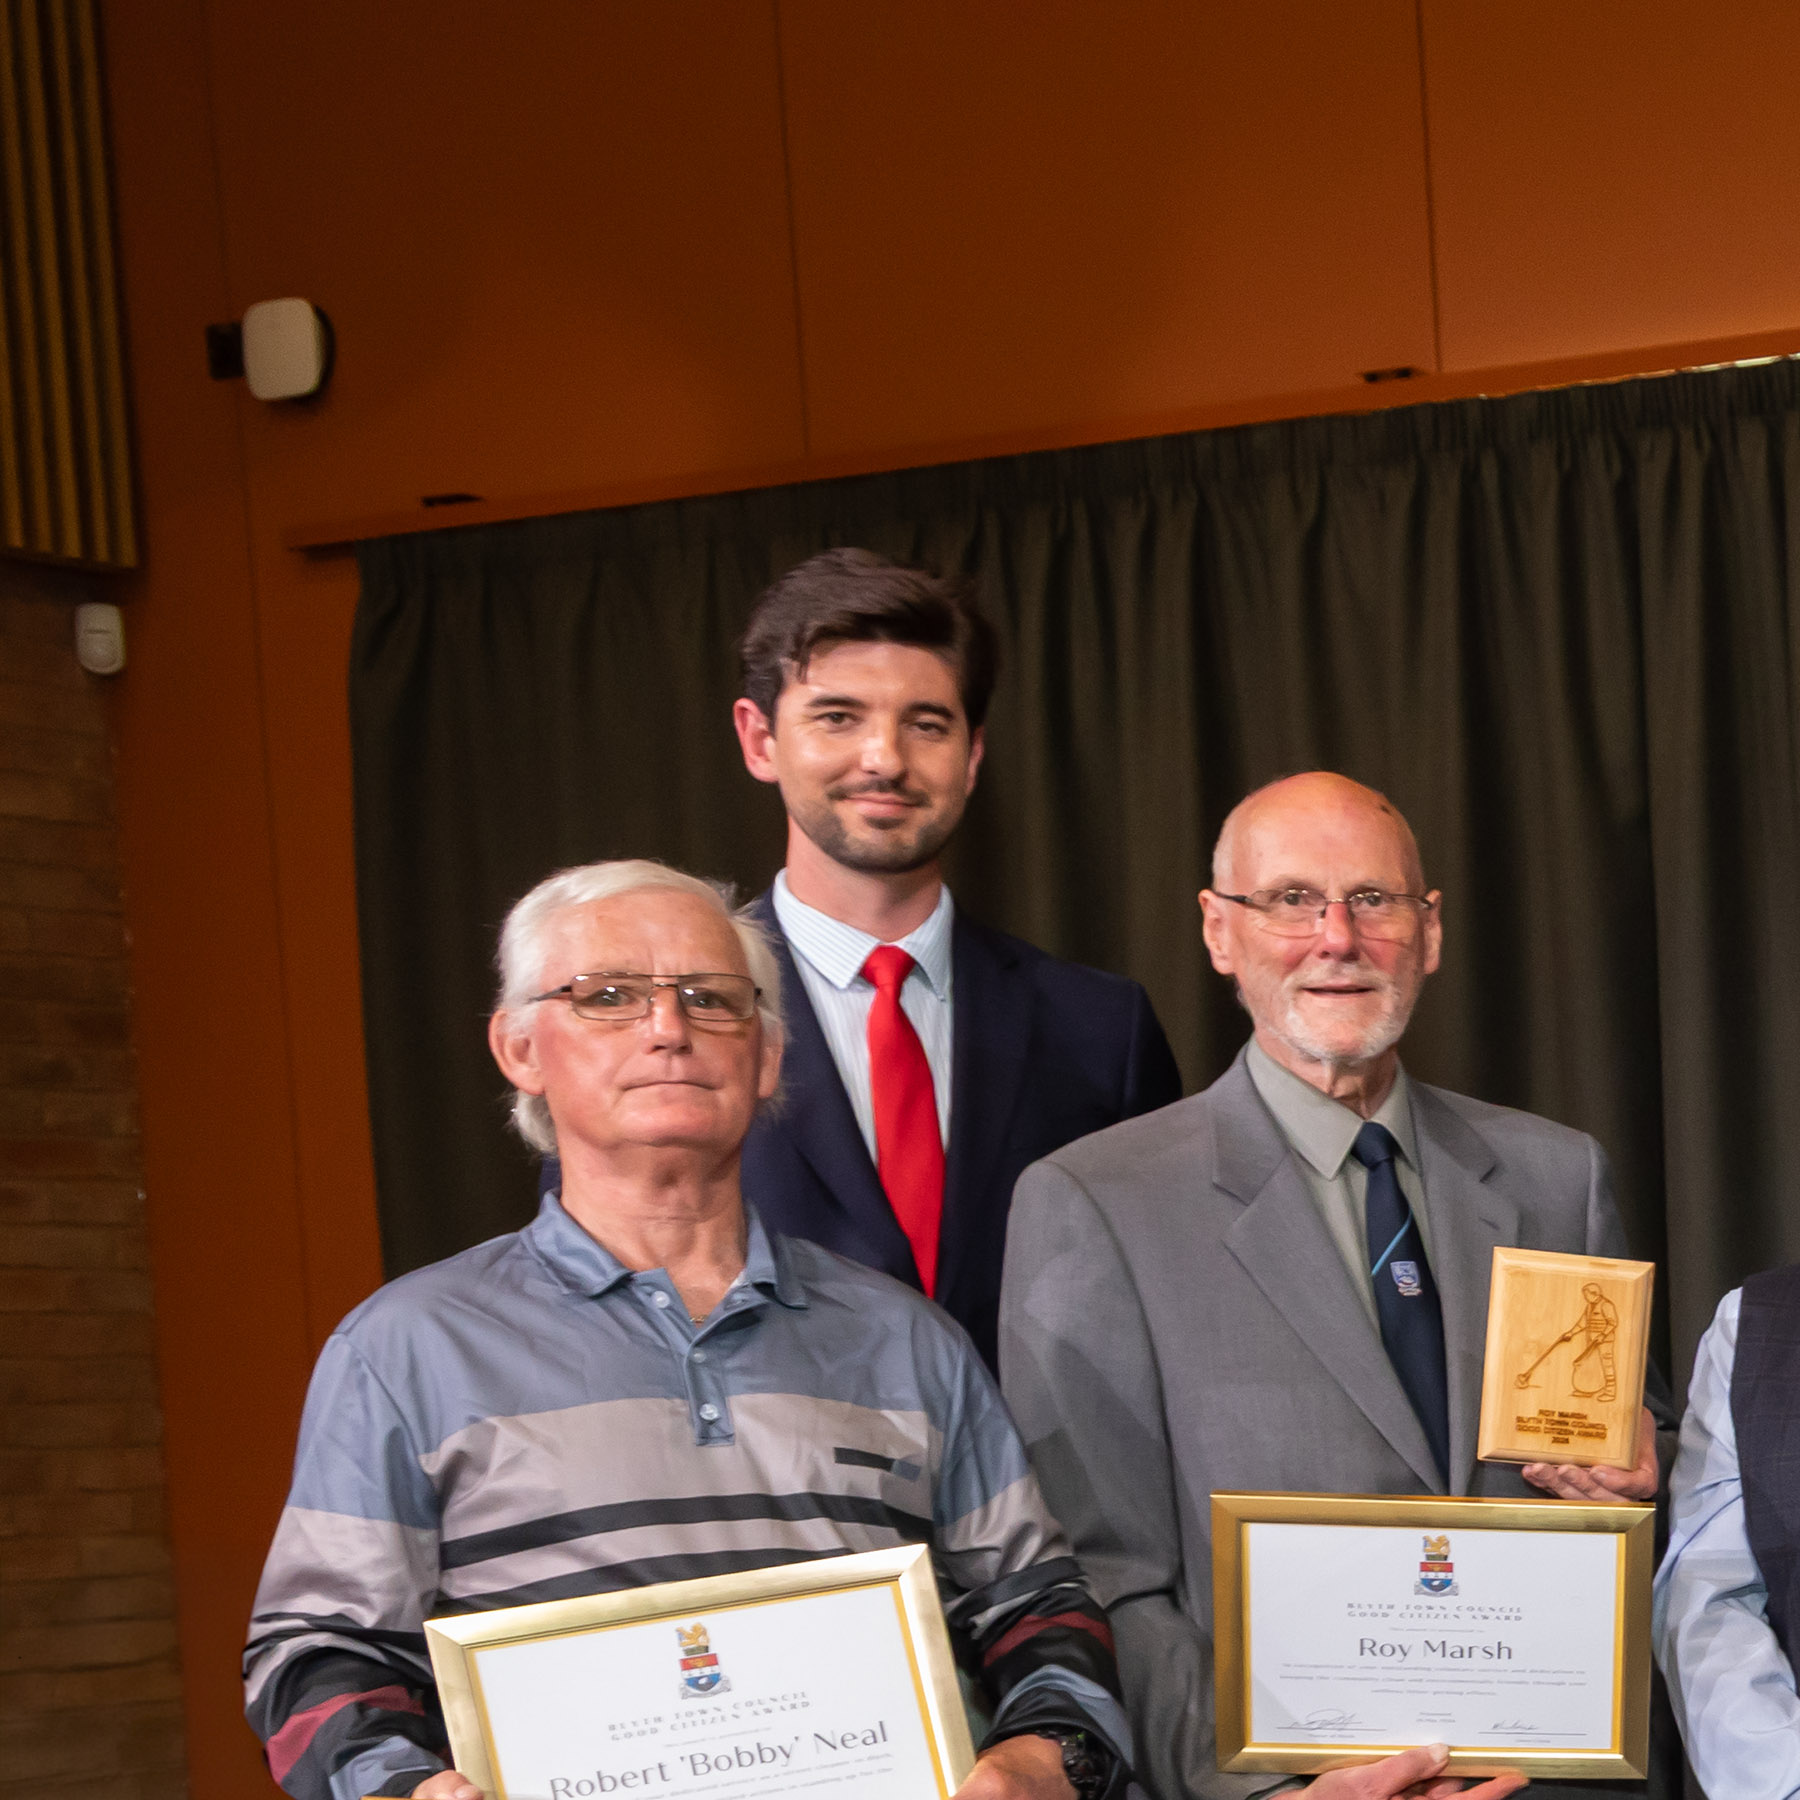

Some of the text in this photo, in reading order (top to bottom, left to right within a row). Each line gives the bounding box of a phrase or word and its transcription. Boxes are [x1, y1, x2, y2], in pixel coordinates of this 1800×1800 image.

[1399, 1612, 1460, 1620] CITIZEN
[1456, 1605, 1521, 1613] COUNCIL
[1359, 1638, 1512, 1662] Roy Marsh
[611, 1727, 659, 1741] GOOD
[670, 1713, 740, 1731] CITIZEN
[752, 1701, 810, 1716] AWARD
[549, 1762, 671, 1800] Robert
[680, 1736, 799, 1776] 'Bobby'
[813, 1720, 888, 1754] Neal
